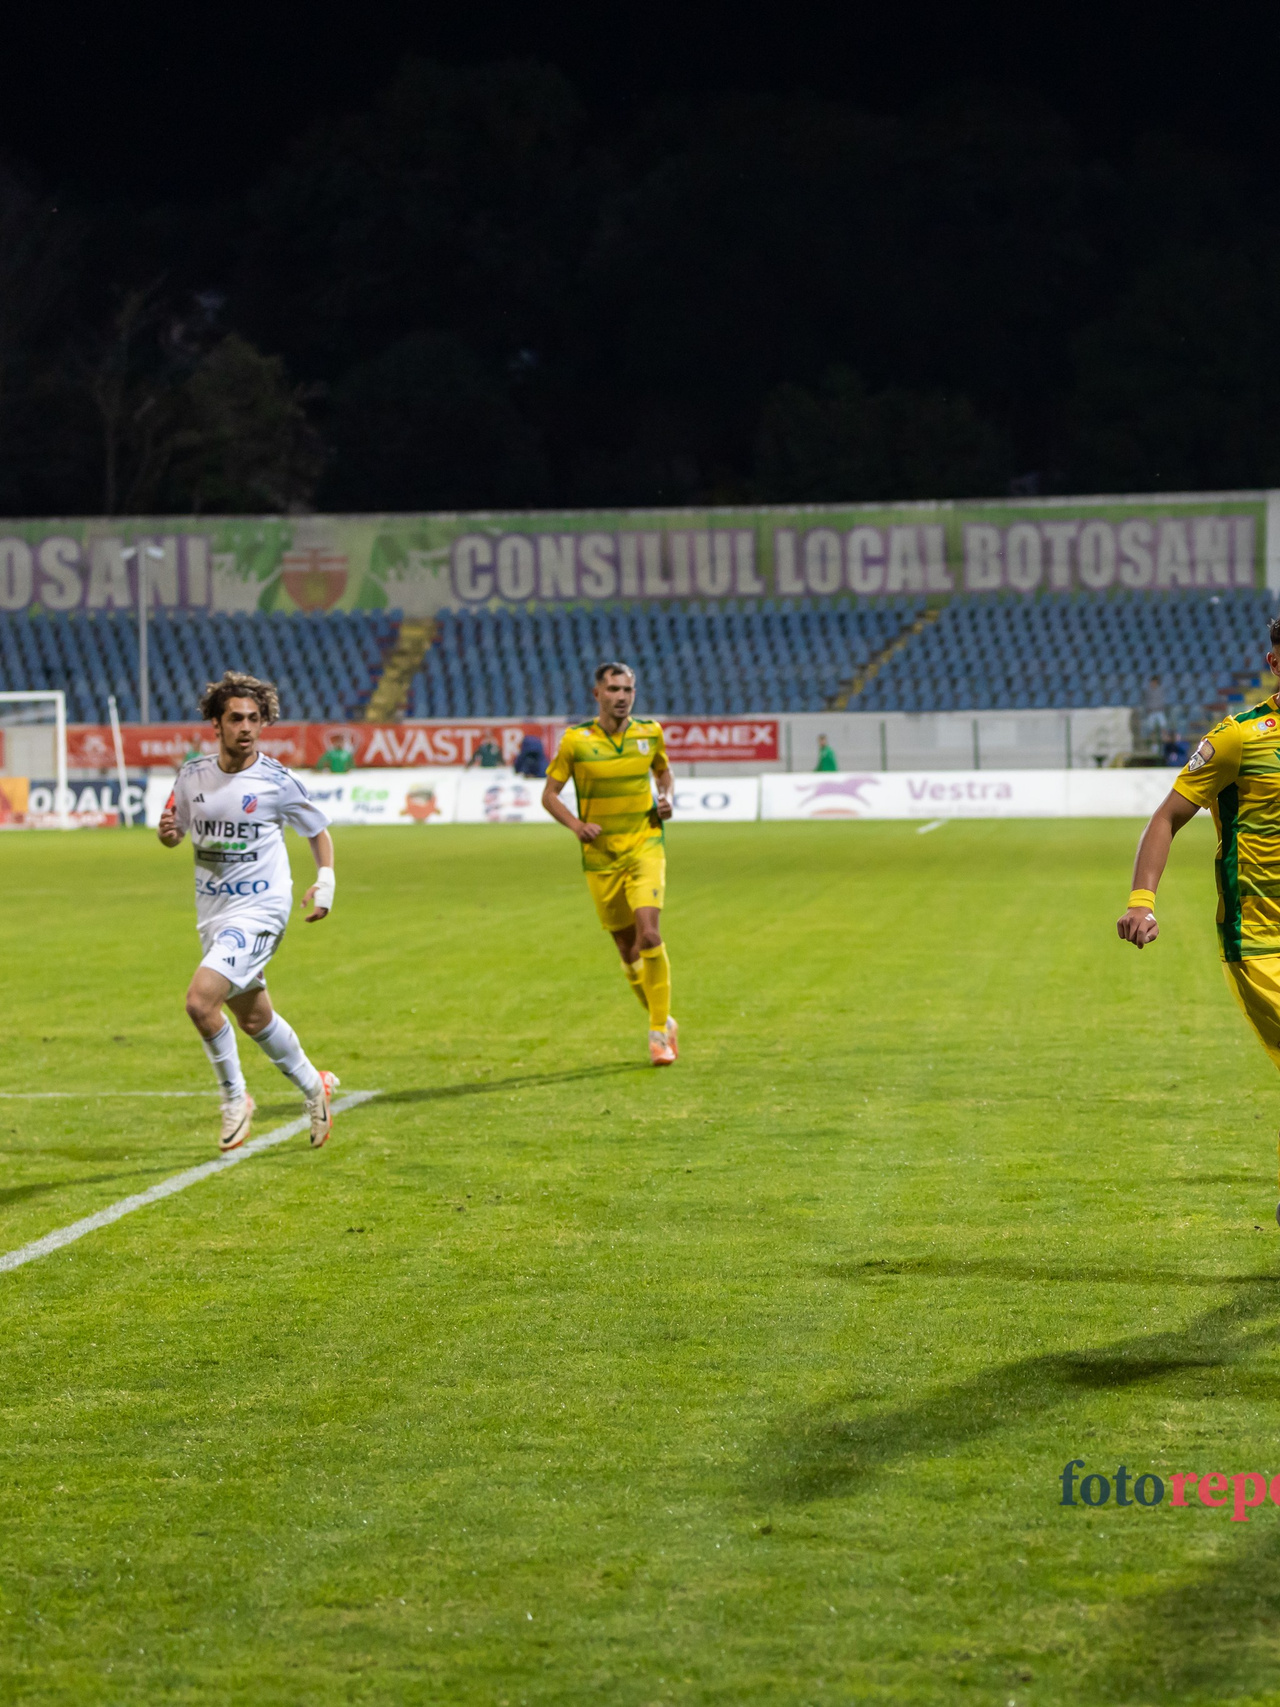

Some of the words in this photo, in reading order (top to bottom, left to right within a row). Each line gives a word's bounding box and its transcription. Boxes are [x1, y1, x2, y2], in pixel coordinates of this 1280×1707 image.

[454, 530, 764, 599] CONSILIUL
[776, 526, 953, 595] LOCAL
[964, 516, 1255, 591] BOTOSANI
[0, 537, 208, 610] OSANI
[364, 729, 524, 763] AVASTR
[663, 725, 774, 746] CANEX
[351, 785, 390, 801] Eco
[907, 778, 1013, 801] Vestra
[194, 820, 264, 839] UNIBET
